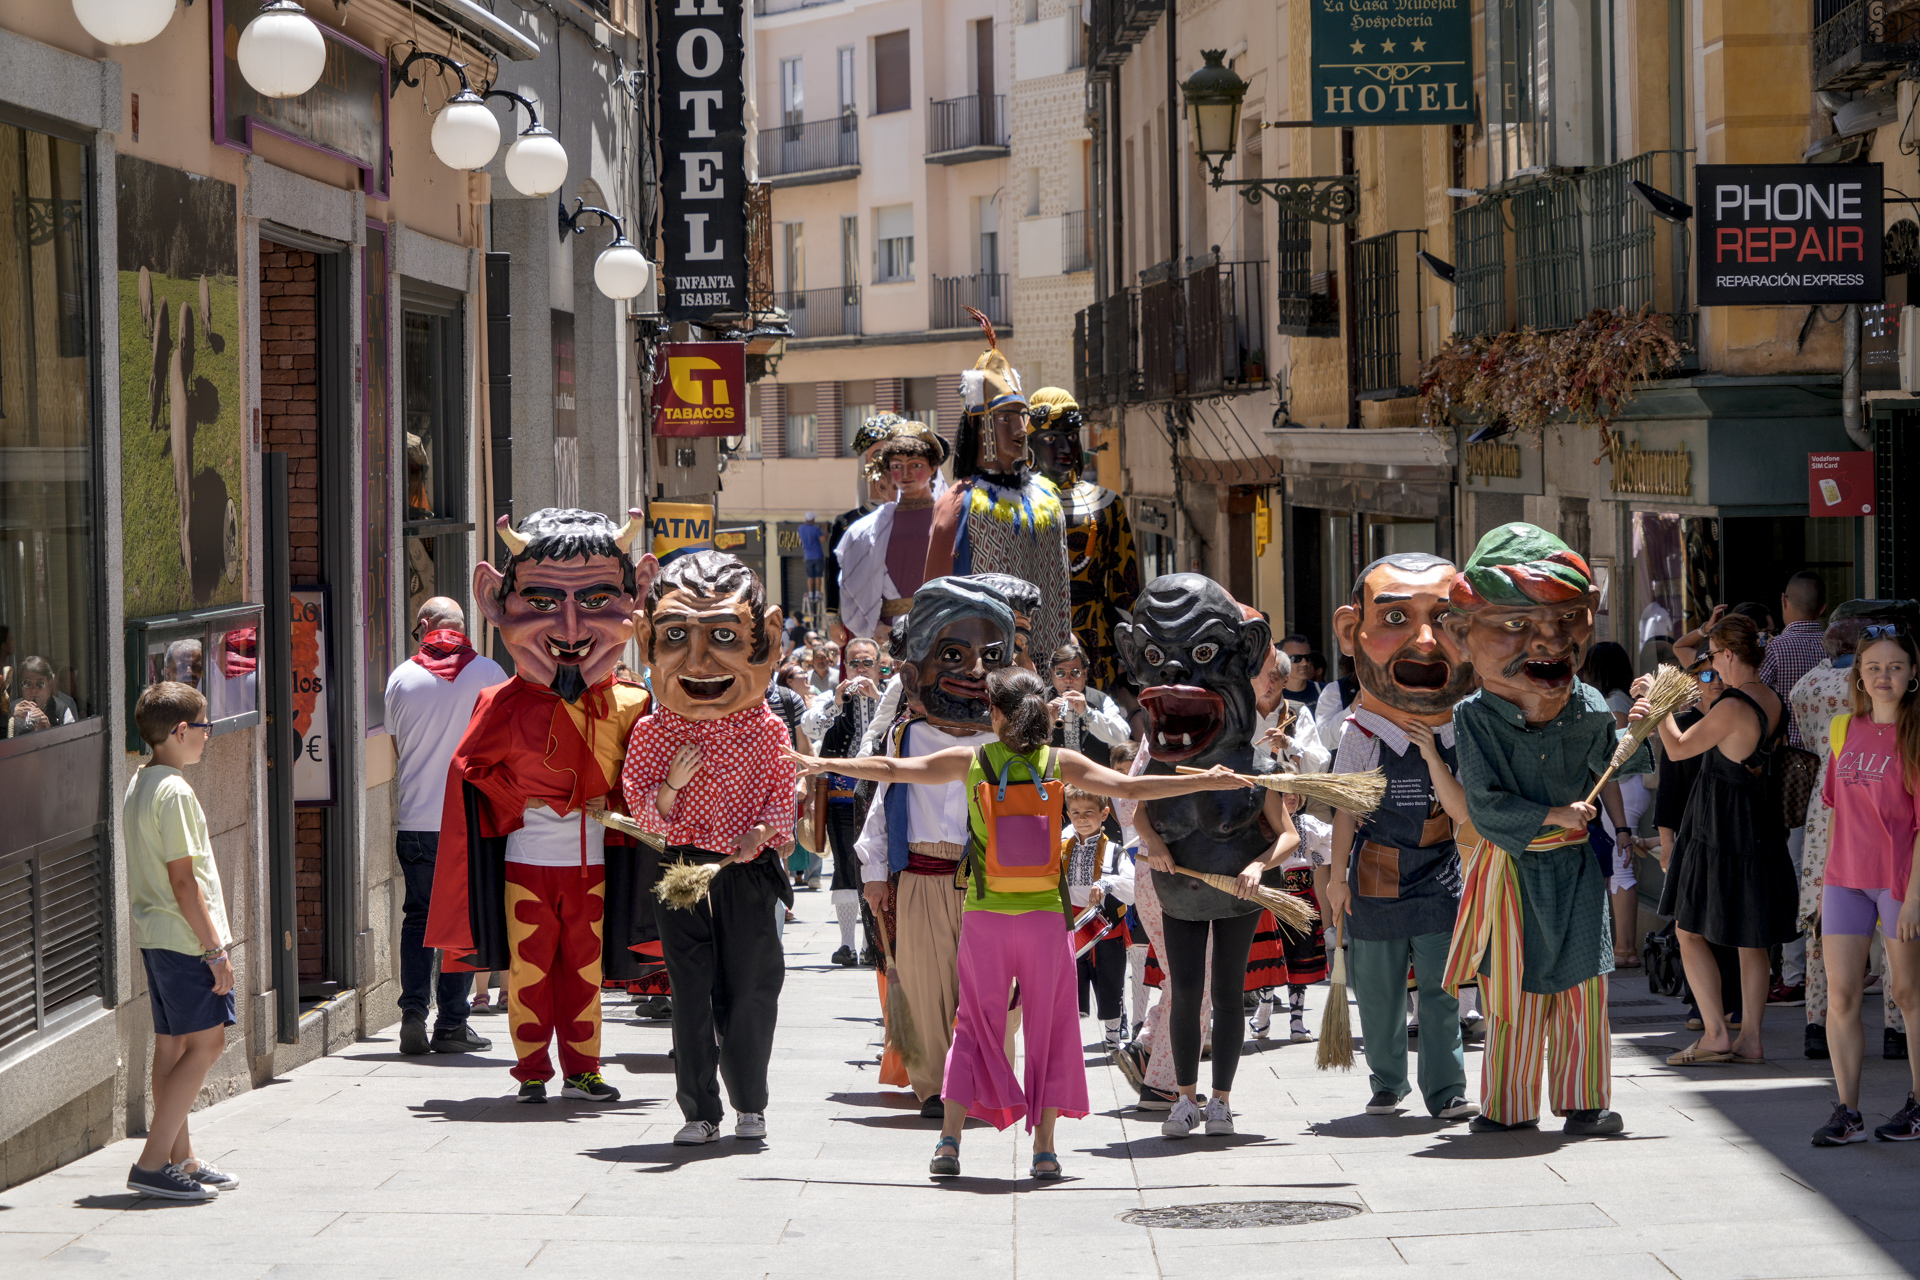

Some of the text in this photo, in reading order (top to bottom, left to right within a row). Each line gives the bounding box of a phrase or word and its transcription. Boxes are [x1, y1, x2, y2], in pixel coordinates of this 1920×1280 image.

[1349, 0, 1389, 12] Casa
[1324, 82, 1468, 114] HOTEL
[1715, 182, 1863, 221] PHONE
[1716, 226, 1865, 263] REPAIR
[675, 275, 736, 291] INFANTA
[1716, 272, 1865, 288] REPARACIÓN EXPRESS
[680, 292, 731, 307] ISABEL
[664, 406, 736, 420] TABACOS
[653, 517, 710, 540] ATM
[290, 601, 319, 623] LO
[291, 671, 323, 694] los
[1836, 751, 1893, 774] CALI
